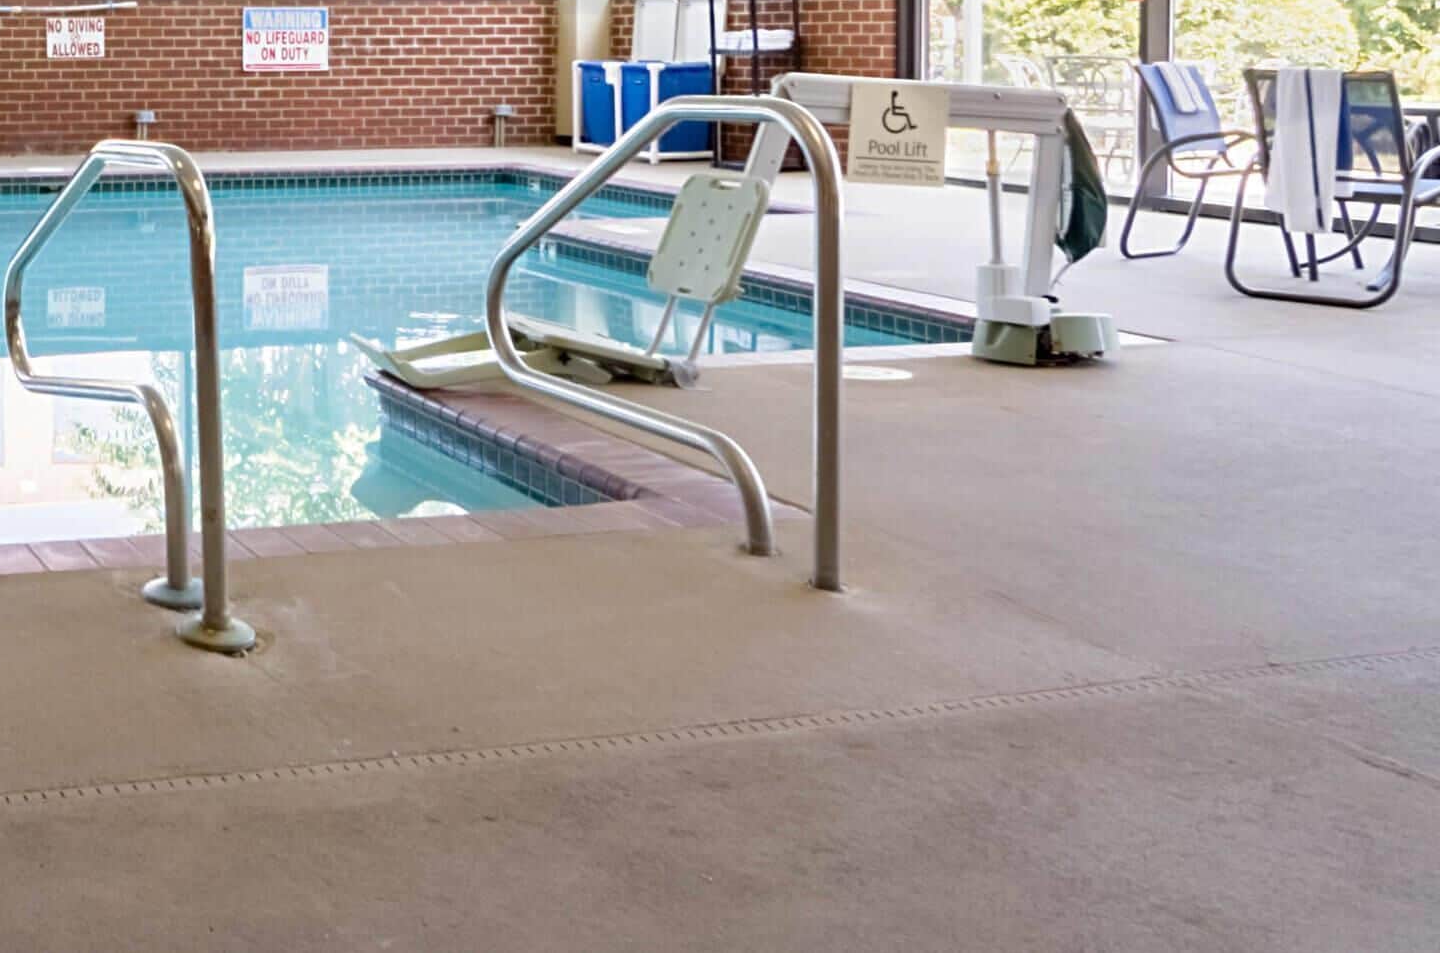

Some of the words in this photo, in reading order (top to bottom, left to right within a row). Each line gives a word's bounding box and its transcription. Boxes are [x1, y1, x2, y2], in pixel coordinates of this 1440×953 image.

[48, 20, 62, 32] NO
[68, 20, 102, 32] DIVING
[248, 11, 321, 28] WARNING
[246, 31, 261, 44] NO
[266, 31, 325, 44] LIFEGUARD
[53, 42, 100, 56] ALLOWED
[261, 48, 276, 60] ON
[281, 48, 309, 60] DUTY
[868, 139, 901, 156] Pool
[904, 141, 928, 158] Lift
